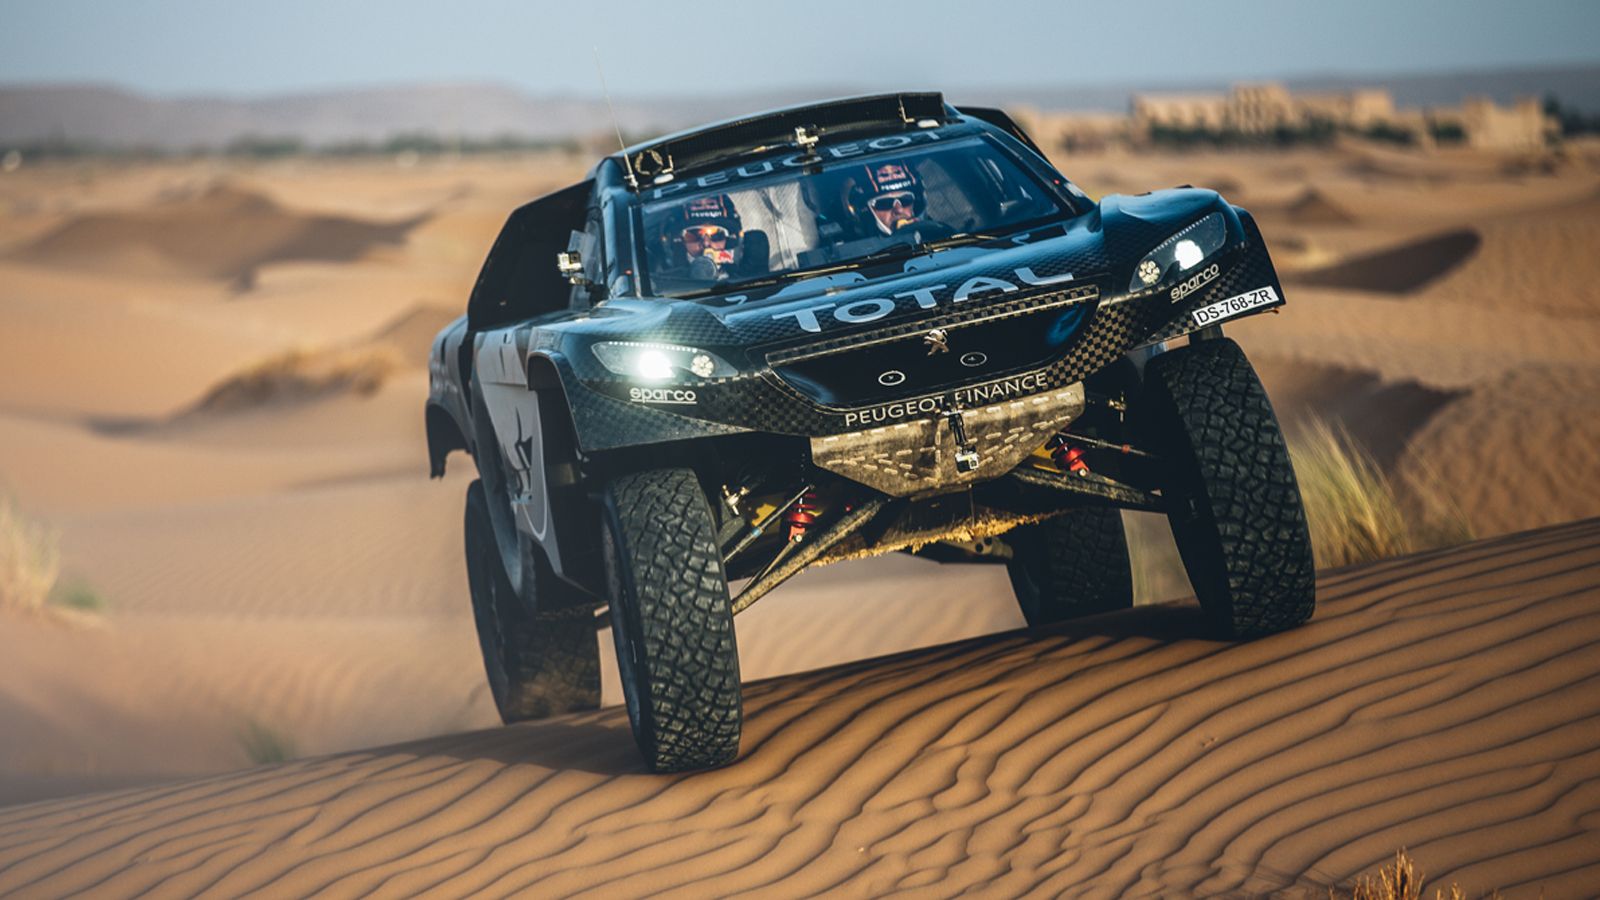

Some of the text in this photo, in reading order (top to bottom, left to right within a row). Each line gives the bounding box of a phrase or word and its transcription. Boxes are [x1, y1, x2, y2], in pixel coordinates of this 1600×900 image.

[1170, 263, 1220, 302] sparco
[771, 267, 1074, 333] TOTAL
[1196, 289, 1272, 323] DS-768-ZR
[629, 387, 697, 404] sparco
[844, 395, 946, 427] PEUGEOT
